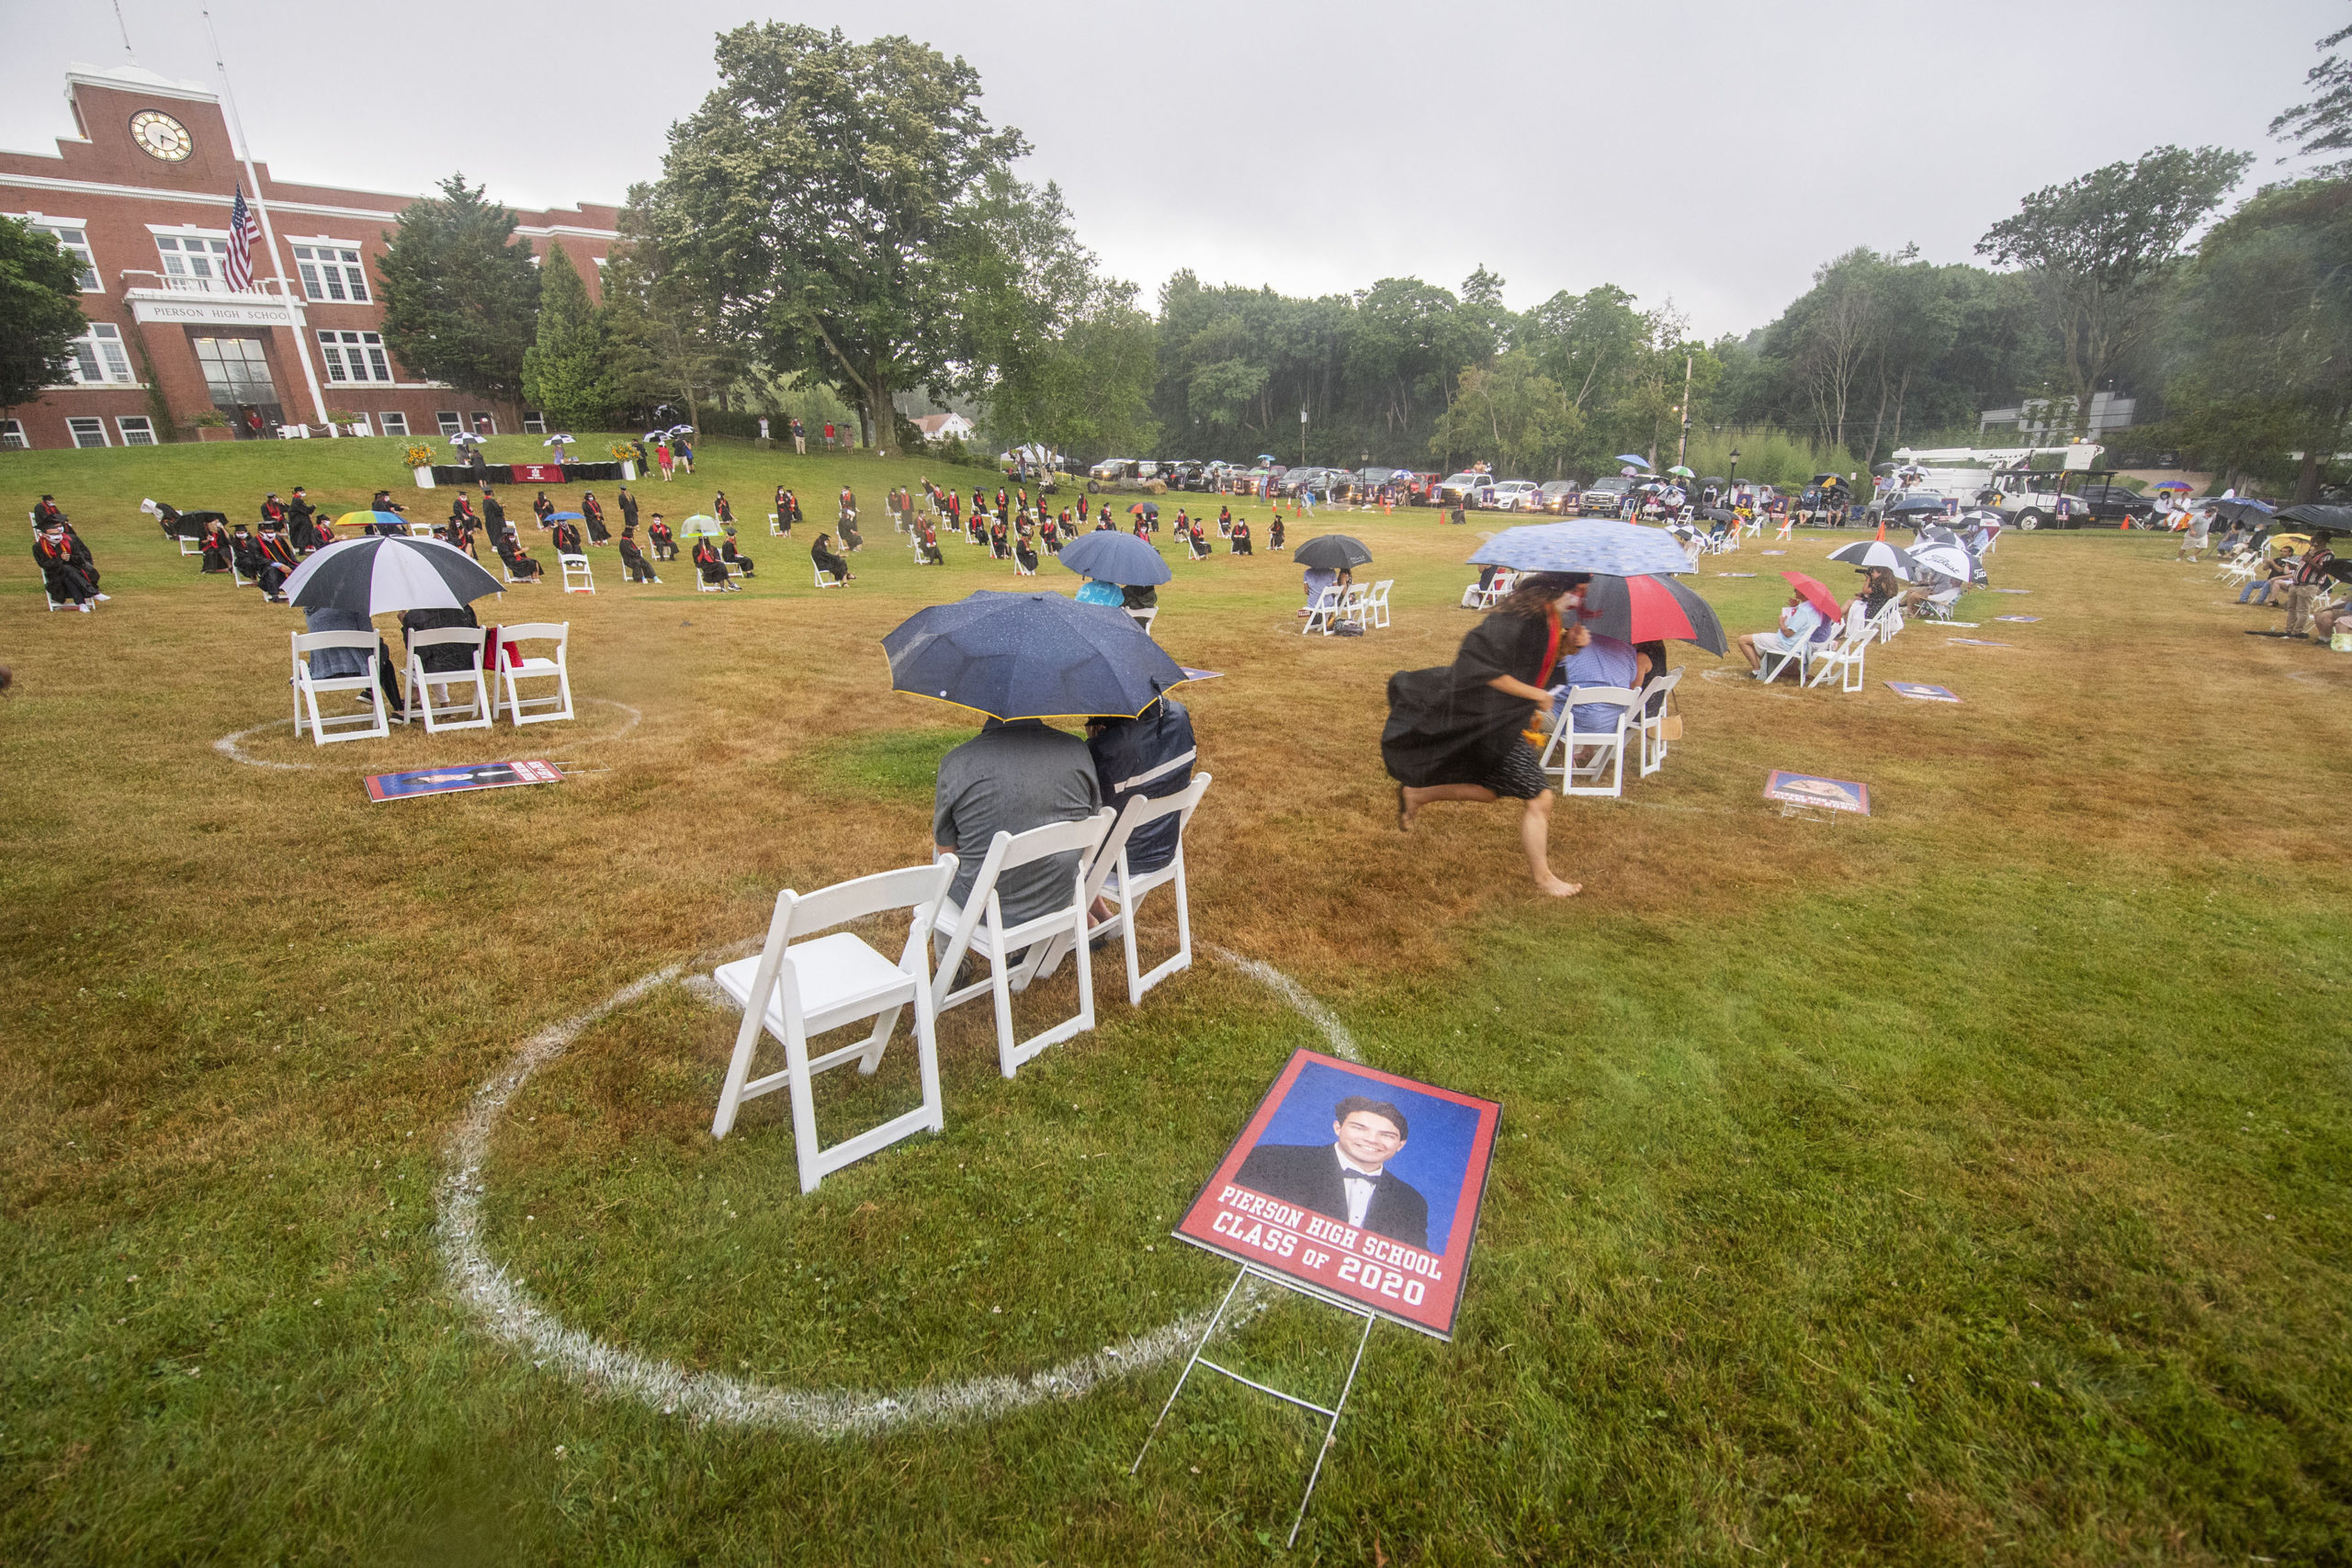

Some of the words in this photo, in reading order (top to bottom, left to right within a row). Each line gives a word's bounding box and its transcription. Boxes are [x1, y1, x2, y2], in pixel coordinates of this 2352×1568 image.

[153, 307, 204, 318] PIERSON
[212, 309, 240, 319] HIGH
[1212, 1211, 1298, 1258] CLASS
[1302, 1248, 1330, 1269] OF
[1337, 1257, 1426, 1306] 2020
[1217, 1185, 1305, 1229] PIERSON
[1306, 1216, 1359, 1249] HIGH
[1362, 1235, 1442, 1280] SCHOOL
